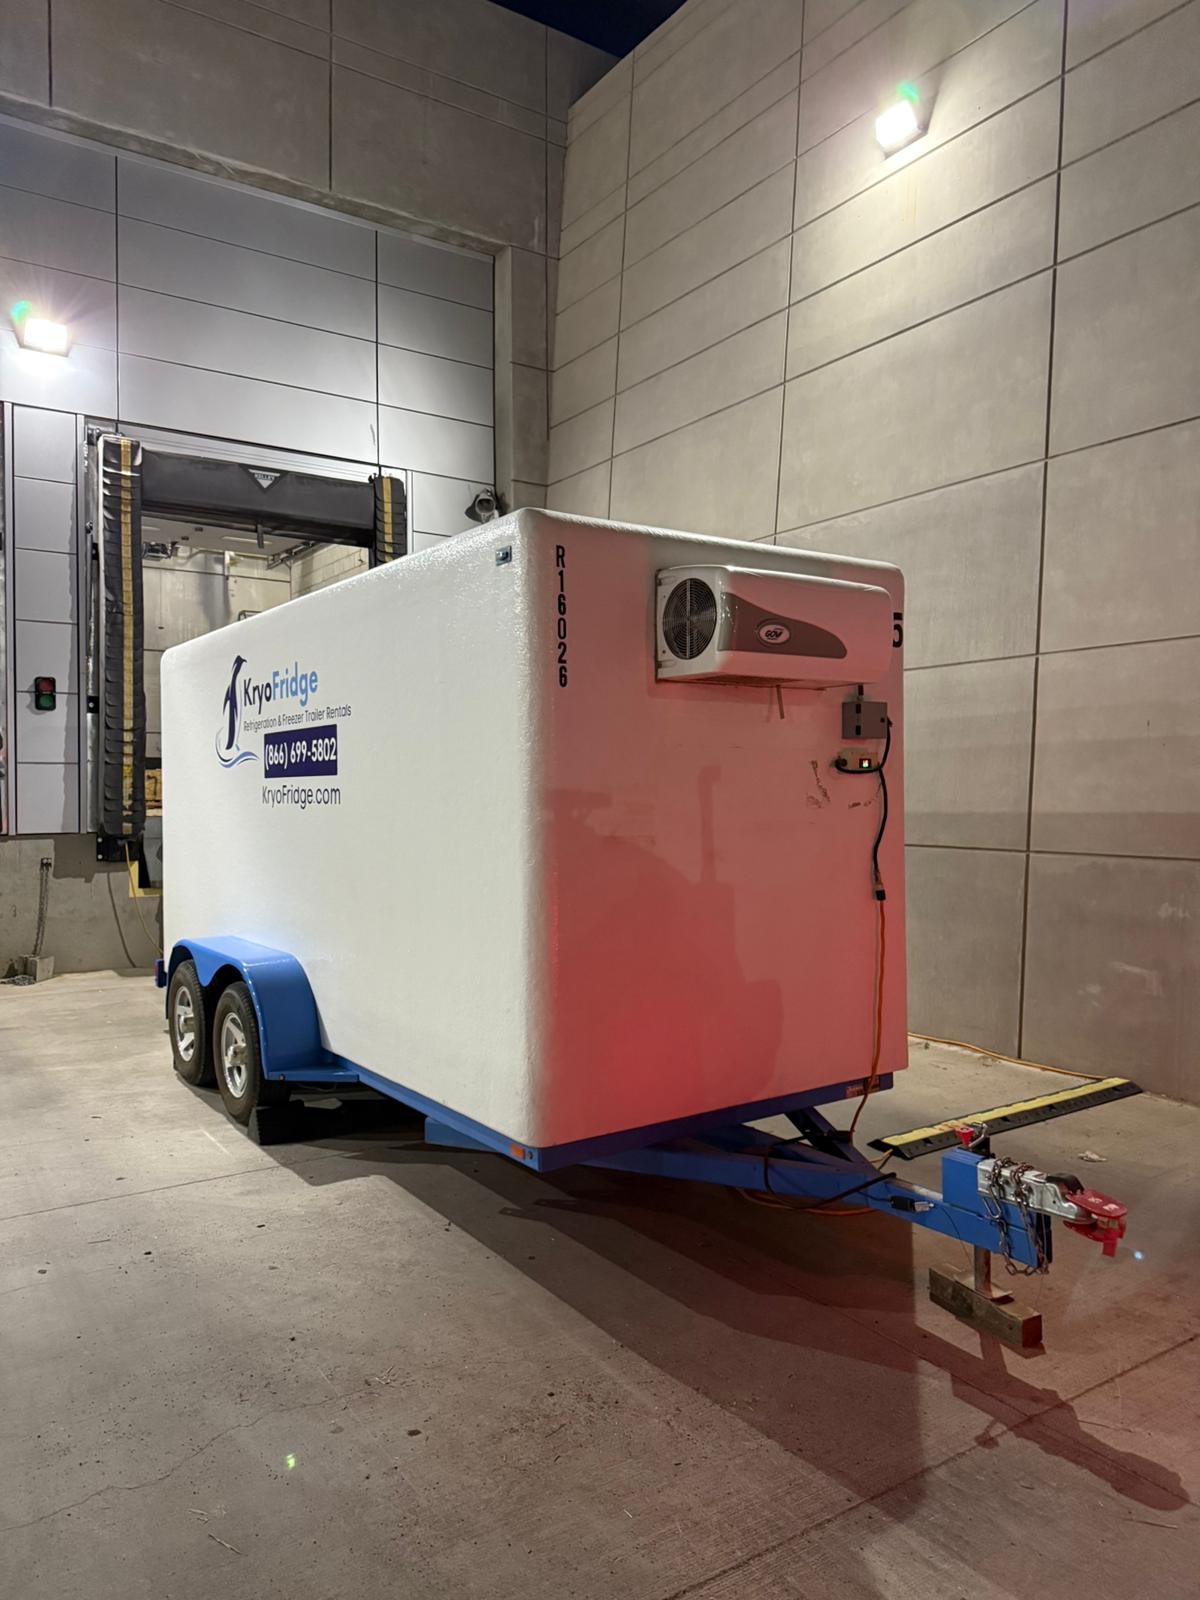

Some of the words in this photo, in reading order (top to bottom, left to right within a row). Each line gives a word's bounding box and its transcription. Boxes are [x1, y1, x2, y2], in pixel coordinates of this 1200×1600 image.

[555, 544, 568, 688] R16026
[243, 661, 318, 715] KryoFridge
[243, 717, 277, 733] Refrigeration
[277, 714, 282, 727] &
[282, 712, 304, 726] Freezer
[305, 708, 326, 723] Trailer
[326, 704, 352, 720] Rentals
[264, 742, 288, 771] (866)
[290, 737, 337, 764] 699-5802
[262, 784, 341, 810] KryoFridge.com
